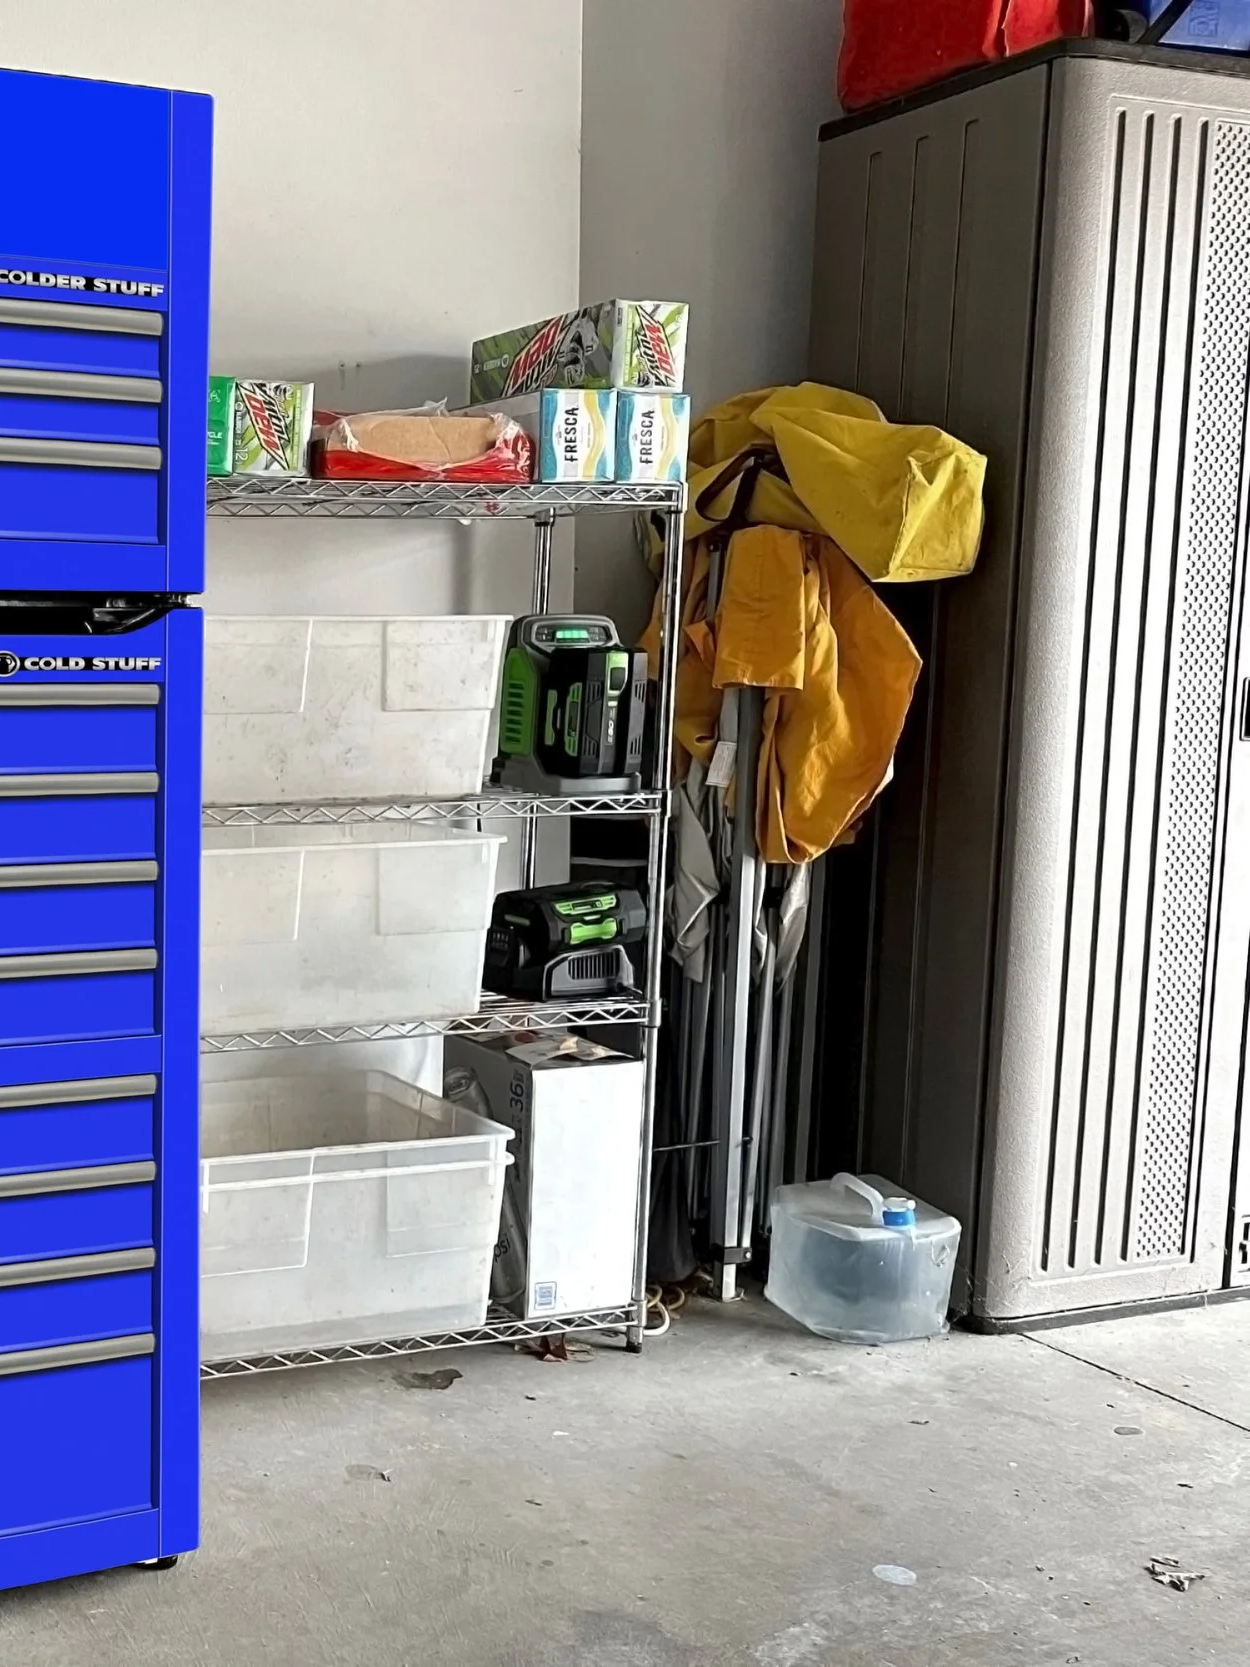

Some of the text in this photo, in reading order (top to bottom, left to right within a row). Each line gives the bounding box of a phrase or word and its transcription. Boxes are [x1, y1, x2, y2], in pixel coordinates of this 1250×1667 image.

[92, 279, 165, 298] STUFF
[564, 407, 579, 462] FRESCA
[640, 410, 655, 464] FRESCA
[24, 656, 162, 671] COLD STUFF
[510, 1081, 524, 1113] 36
[494, 1233, 511, 1263] psi
